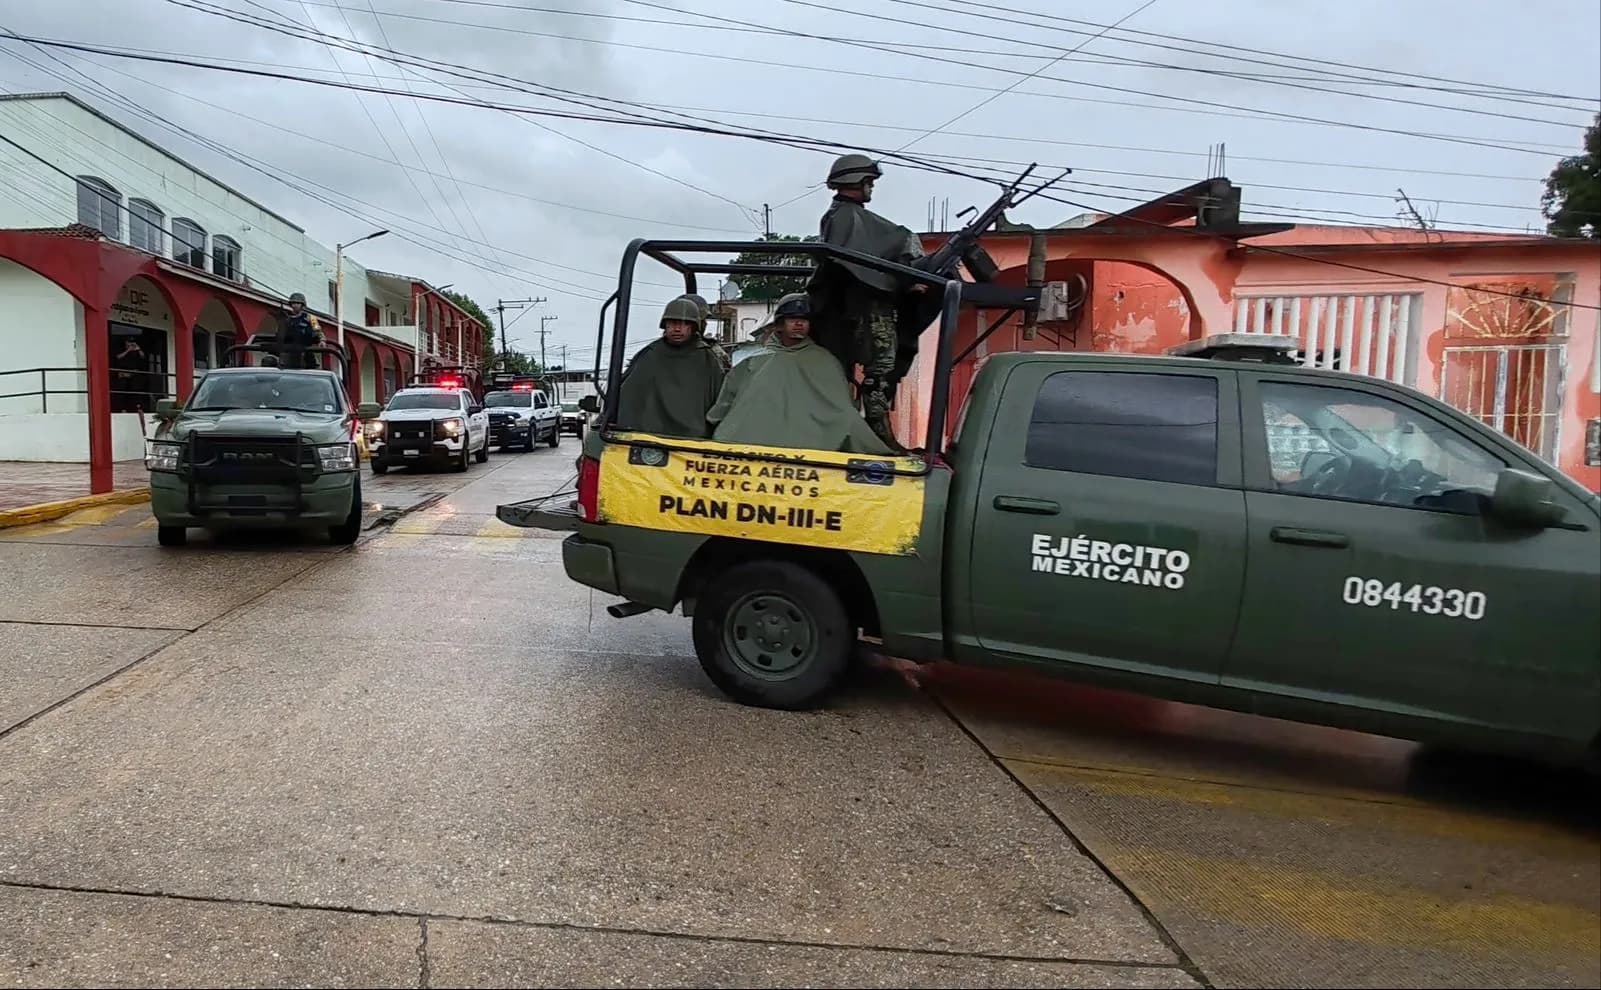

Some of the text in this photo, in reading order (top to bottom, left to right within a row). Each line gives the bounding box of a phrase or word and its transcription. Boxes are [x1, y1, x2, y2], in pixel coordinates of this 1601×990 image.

[683, 476, 820, 498] MEXICANOS
[685, 459, 820, 482] FUERZA AÉREA
[659, 494, 842, 531] PLAN DN-III-E
[1031, 533, 1190, 573] EJÉRCITO
[1032, 555, 1185, 589] MEXICANO
[1343, 576, 1487, 620] 0844330
